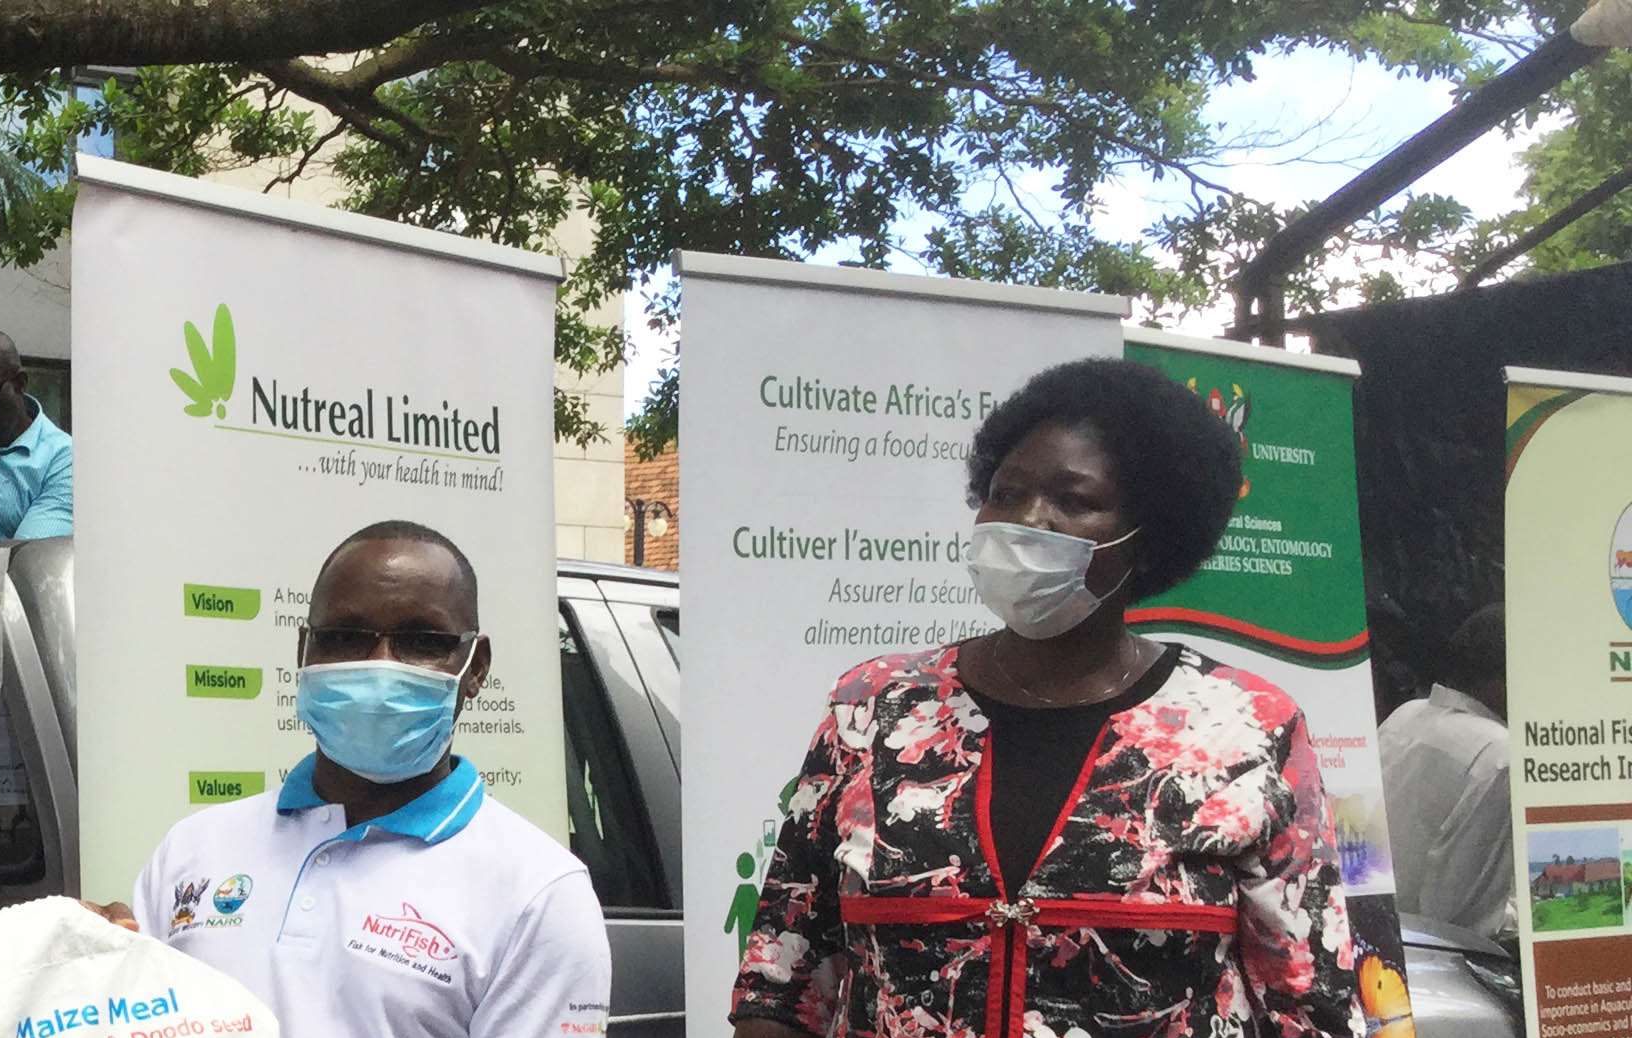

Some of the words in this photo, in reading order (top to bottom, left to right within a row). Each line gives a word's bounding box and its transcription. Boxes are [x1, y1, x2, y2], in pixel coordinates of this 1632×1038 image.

[759, 374, 878, 414] Cultivate
[884, 383, 972, 420] Africa's
[252, 375, 374, 440] Nutreal
[387, 394, 500, 455] Limited
[775, 425, 860, 462] Ensuring
[864, 439, 878, 457] a
[883, 430, 929, 459] food
[1252, 443, 1316, 465] UNIVERSITY
[359, 460, 393, 487] your
[395, 455, 440, 487] health
[444, 465, 458, 489] in
[461, 468, 503, 492] mind!
[1244, 515, 1282, 531] Sciences
[732, 525, 837, 561] Cultiver
[844, 527, 941, 563] l'avenir
[1261, 538, 1333, 558] ENTOMOLOGY
[1243, 556, 1293, 575] SCIENCES
[274, 588, 285, 605] A
[827, 577, 903, 604] Assurer
[907, 577, 927, 604] la
[192, 593, 235, 613] Vision
[804, 618, 920, 646] alimentaire
[924, 620, 946, 646] de
[194, 671, 246, 690] Mission
[276, 668, 292, 684] To
[476, 697, 515, 712] foods
[458, 719, 525, 736] materials.
[1524, 718, 1605, 748] National
[1523, 754, 1612, 783] Research
[197, 779, 242, 797] Values
[205, 917, 242, 927] NARO
[361, 914, 440, 955] NutriFish
[347, 939, 363, 950] Fish
[365, 944, 377, 954] for
[379, 947, 410, 966] Nutrition
[412, 961, 428, 973] and
[427, 965, 452, 985] Health
[1544, 983, 1556, 999] To
[1556, 982, 1592, 999] conduct
[1592, 980, 1614, 997] basic
[1615, 978, 1632, 993] and
[108, 987, 180, 1025] Meal
[1540, 1002, 1589, 1020] importance
[1590, 1001, 1599, 1014] in
[211, 1014, 253, 1033] seed
[1612, 1017, 1629, 1032] and
